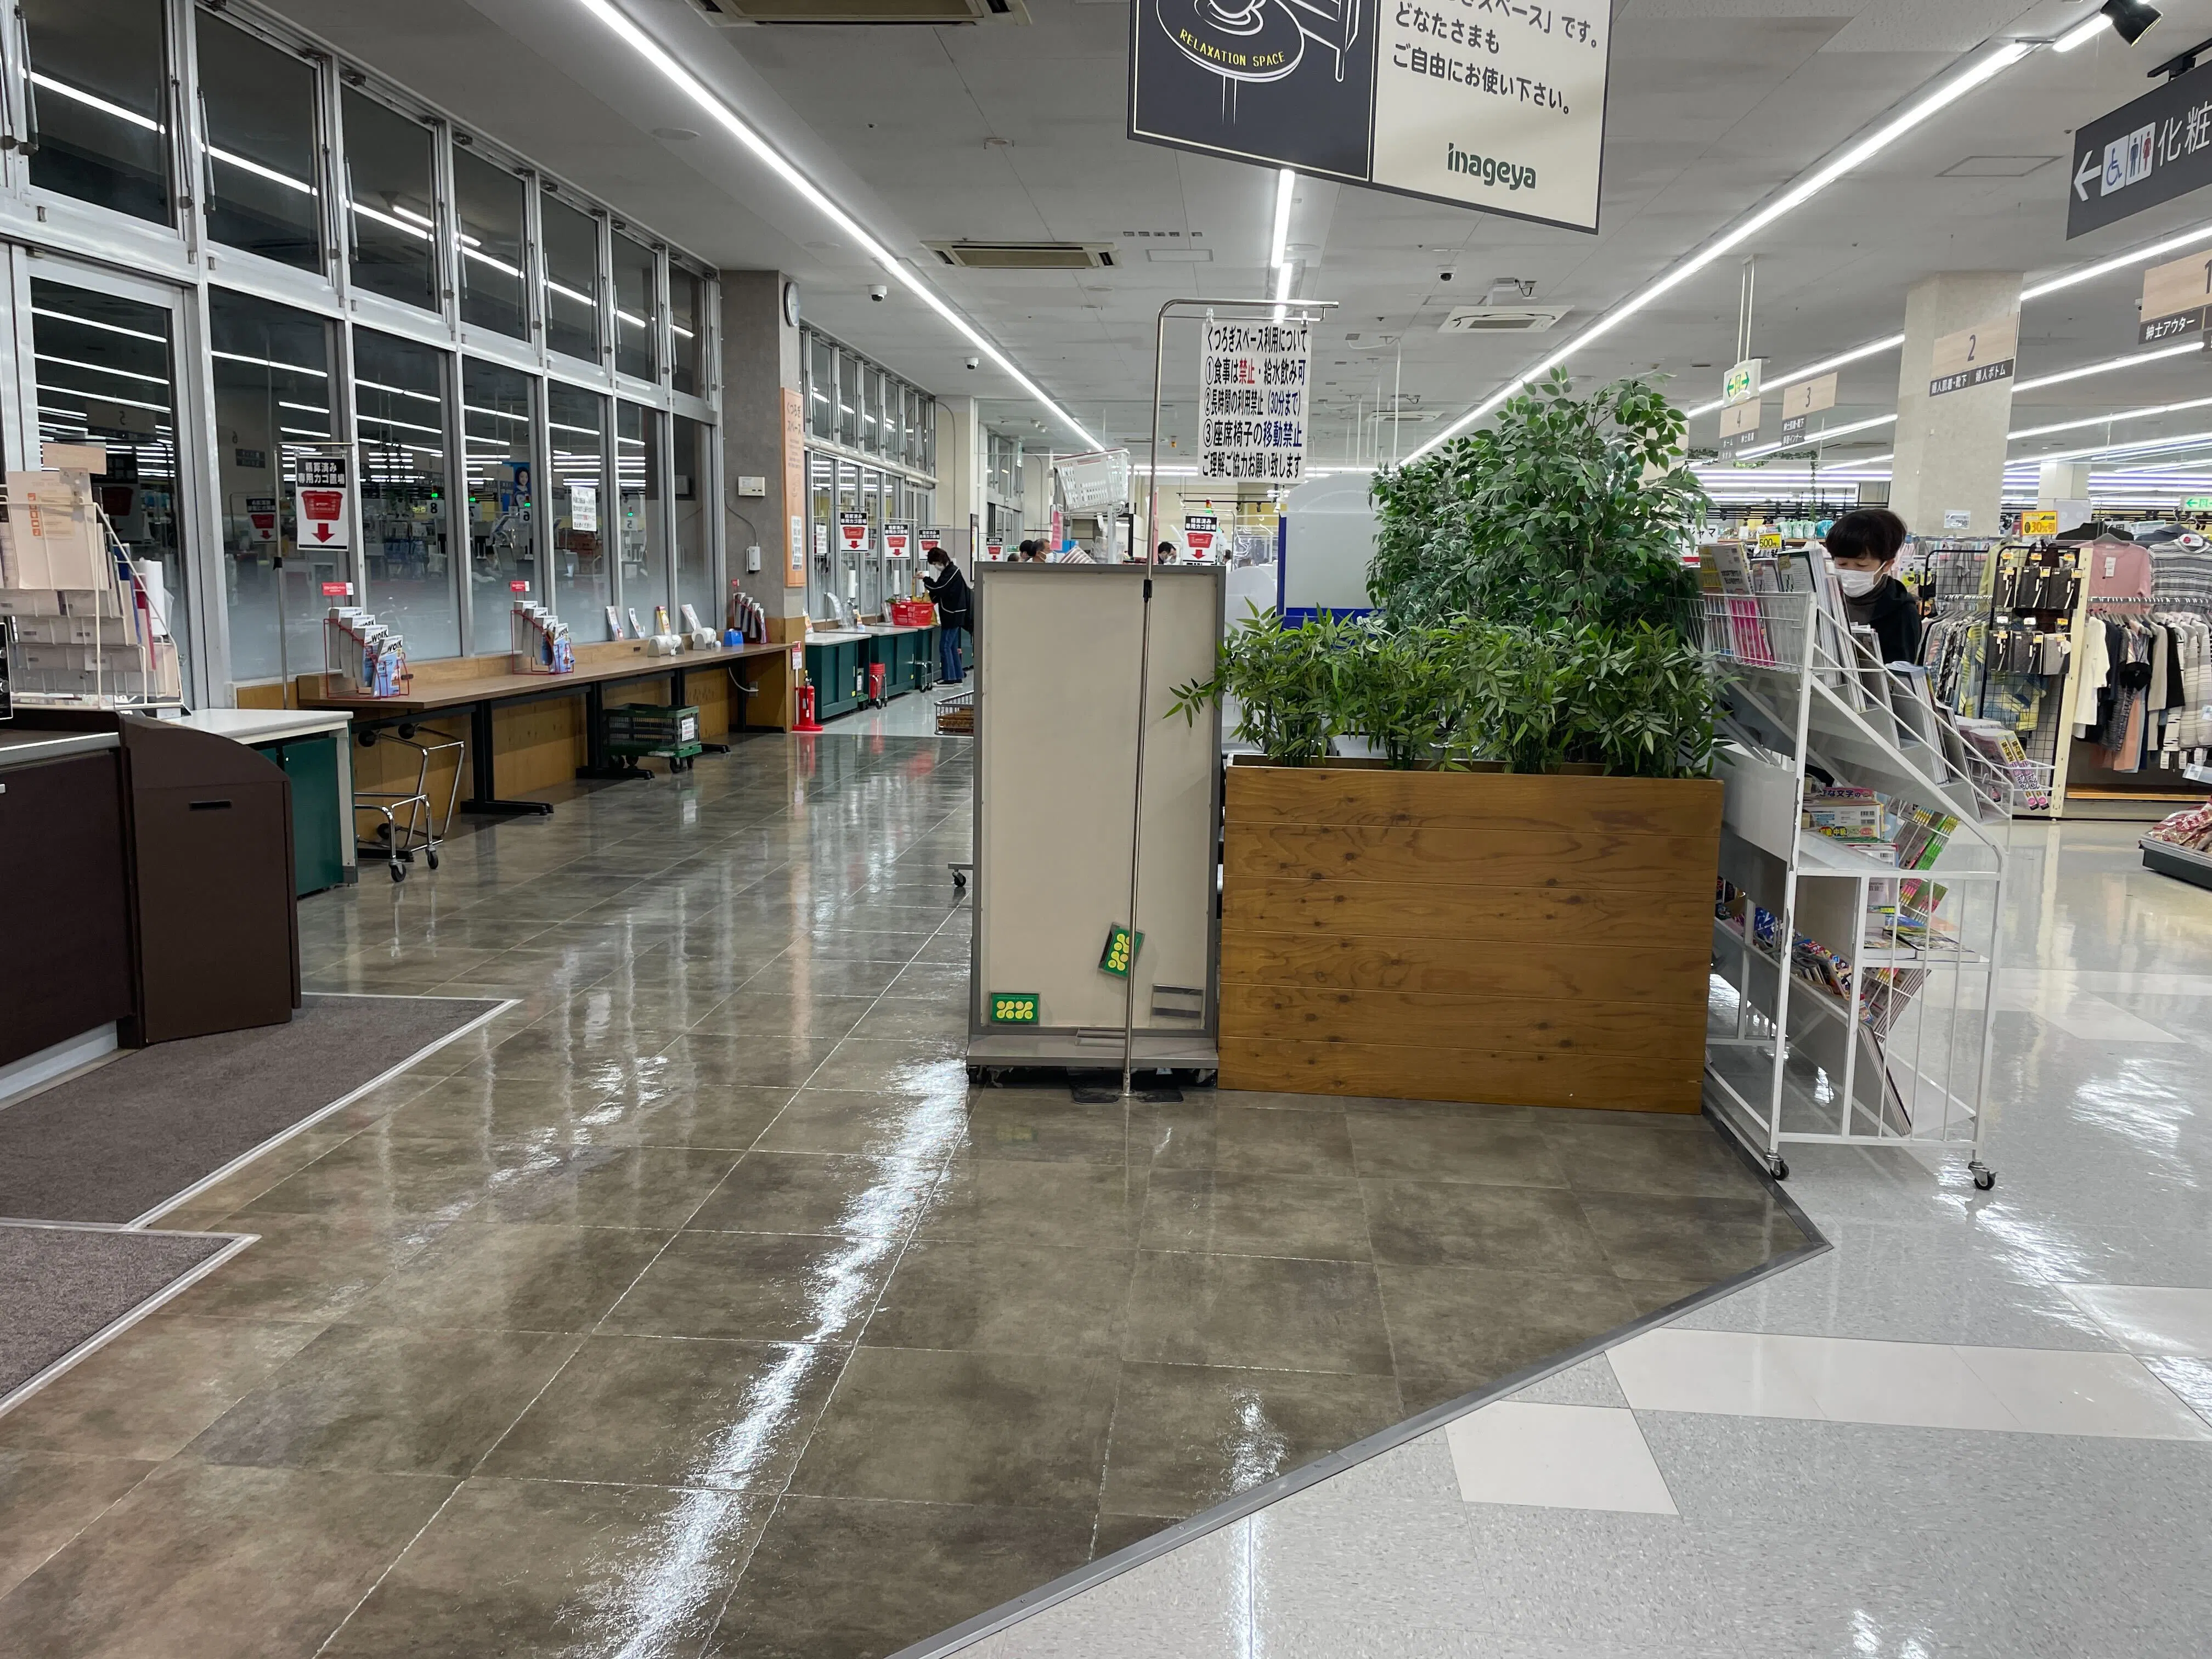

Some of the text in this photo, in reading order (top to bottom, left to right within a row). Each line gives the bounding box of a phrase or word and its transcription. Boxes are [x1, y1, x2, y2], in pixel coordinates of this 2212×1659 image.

[1395, 1, 1499, 54] どなたさまも
[1180, 28, 1285, 67] RELAXATION SPACE
[1393, 43, 1569, 115] ご自由にお使い下さい。
[2158, 100, 2212, 167] 化粧
[1447, 142, 1537, 191] inageya
[1207, 324, 1307, 354] くつろぎスペース利用について
[2145, 316, 2196, 341] 紳士アウター
[1967, 334, 1976, 362] 2
[1974, 363, 2006, 383] 婦人ボトム
[787, 402, 801, 418] くつろぎ
[1805, 386, 1811, 408] 3
[787, 420, 802, 435] スペース
[1203, 418, 1302, 448] ③座席椅子の移動禁止
[1736, 410, 1742, 428] 4
[1202, 450, 1302, 479] ご理解ご協力お願い致します
[371, 629, 388, 643] WORK
